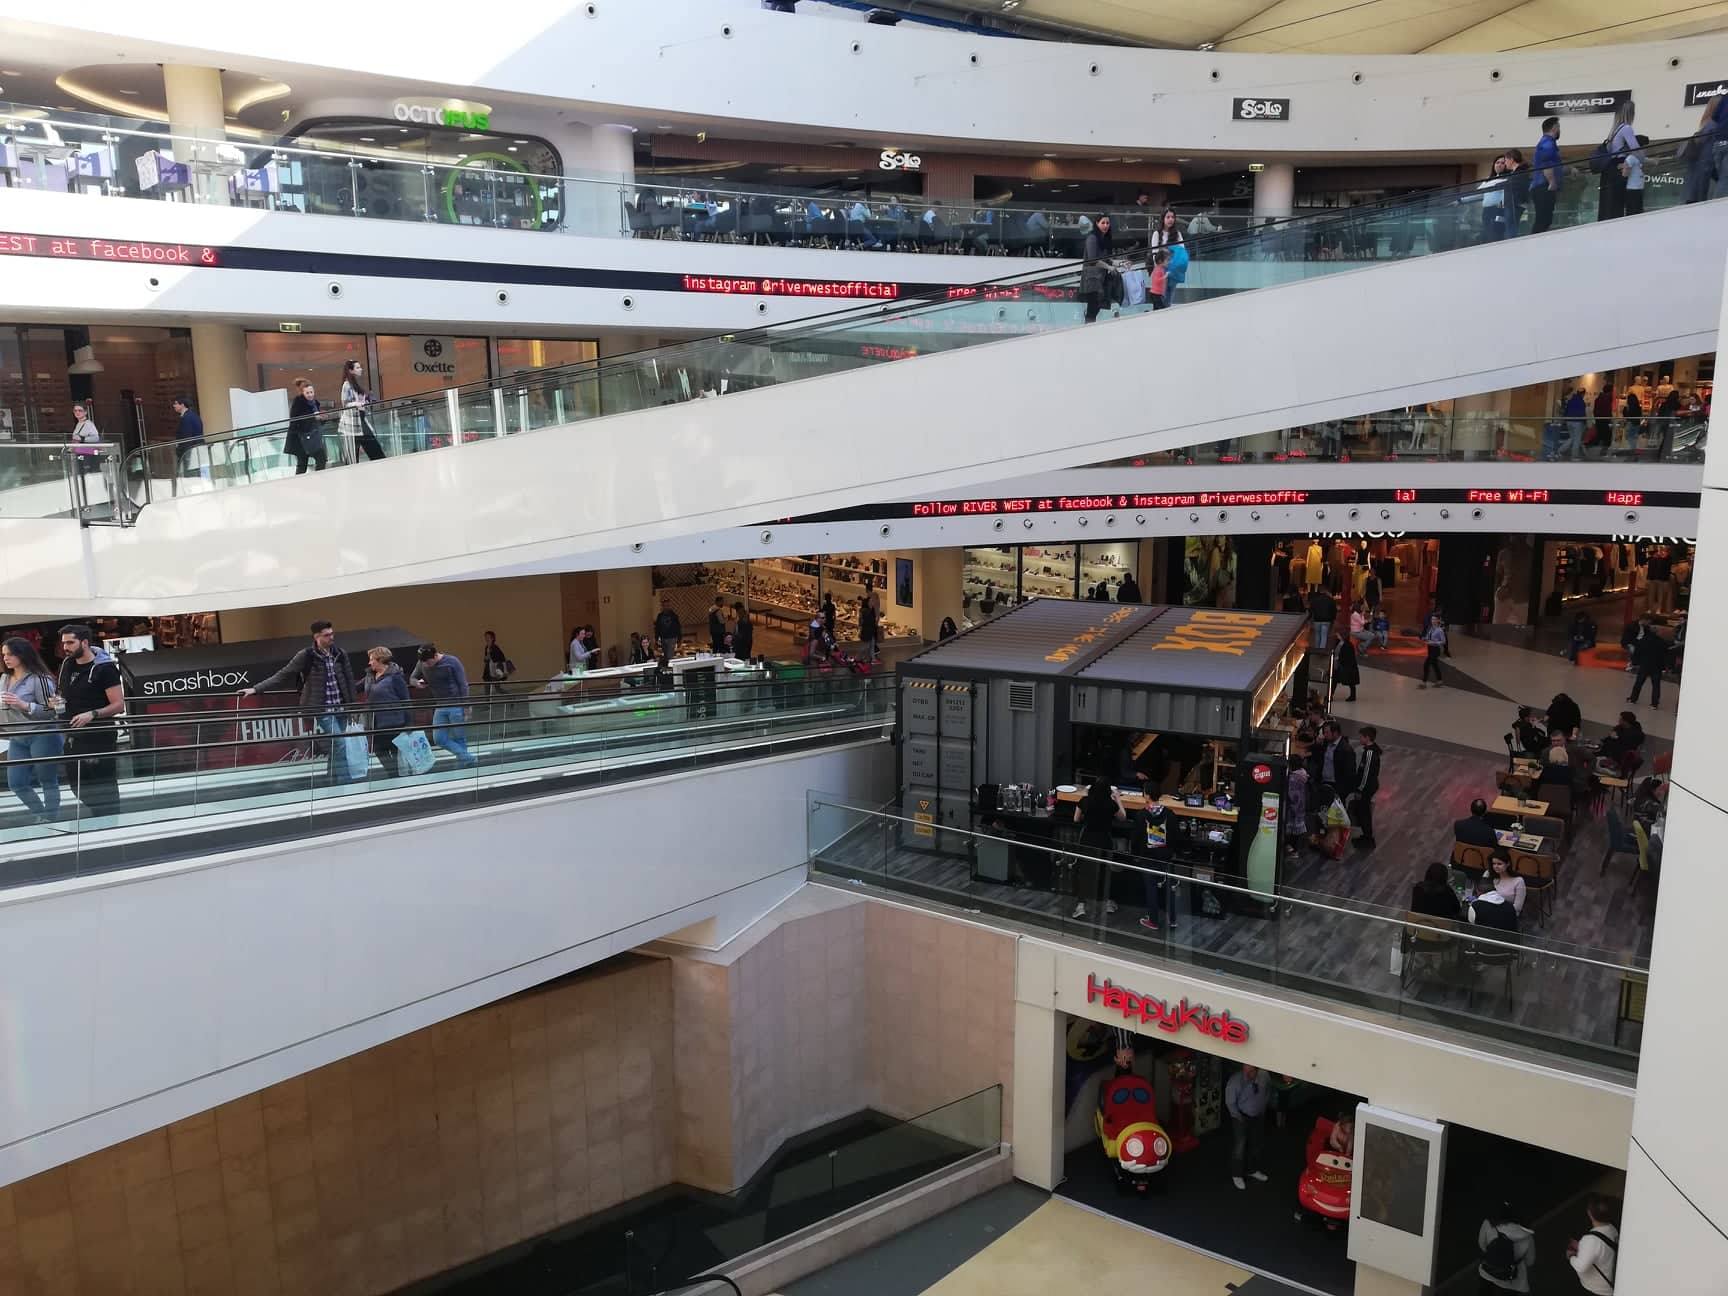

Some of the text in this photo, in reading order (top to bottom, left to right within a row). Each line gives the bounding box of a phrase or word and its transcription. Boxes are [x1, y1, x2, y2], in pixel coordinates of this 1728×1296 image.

[1543, 97, 1615, 109] EDWARD
[1643, 174, 1685, 185] DWARD
[52, 240, 77, 255] at
[91, 240, 189, 261] facebook
[201, 247, 215, 263] &
[684, 275, 898, 297] instagram @riverwestofficial
[914, 491, 1309, 515] Follow RIVER WEST at facebook & instagram @riverwestoffic
[1470, 490, 1549, 501] Free Wi-Fi
[143, 670, 250, 695] smashbox
